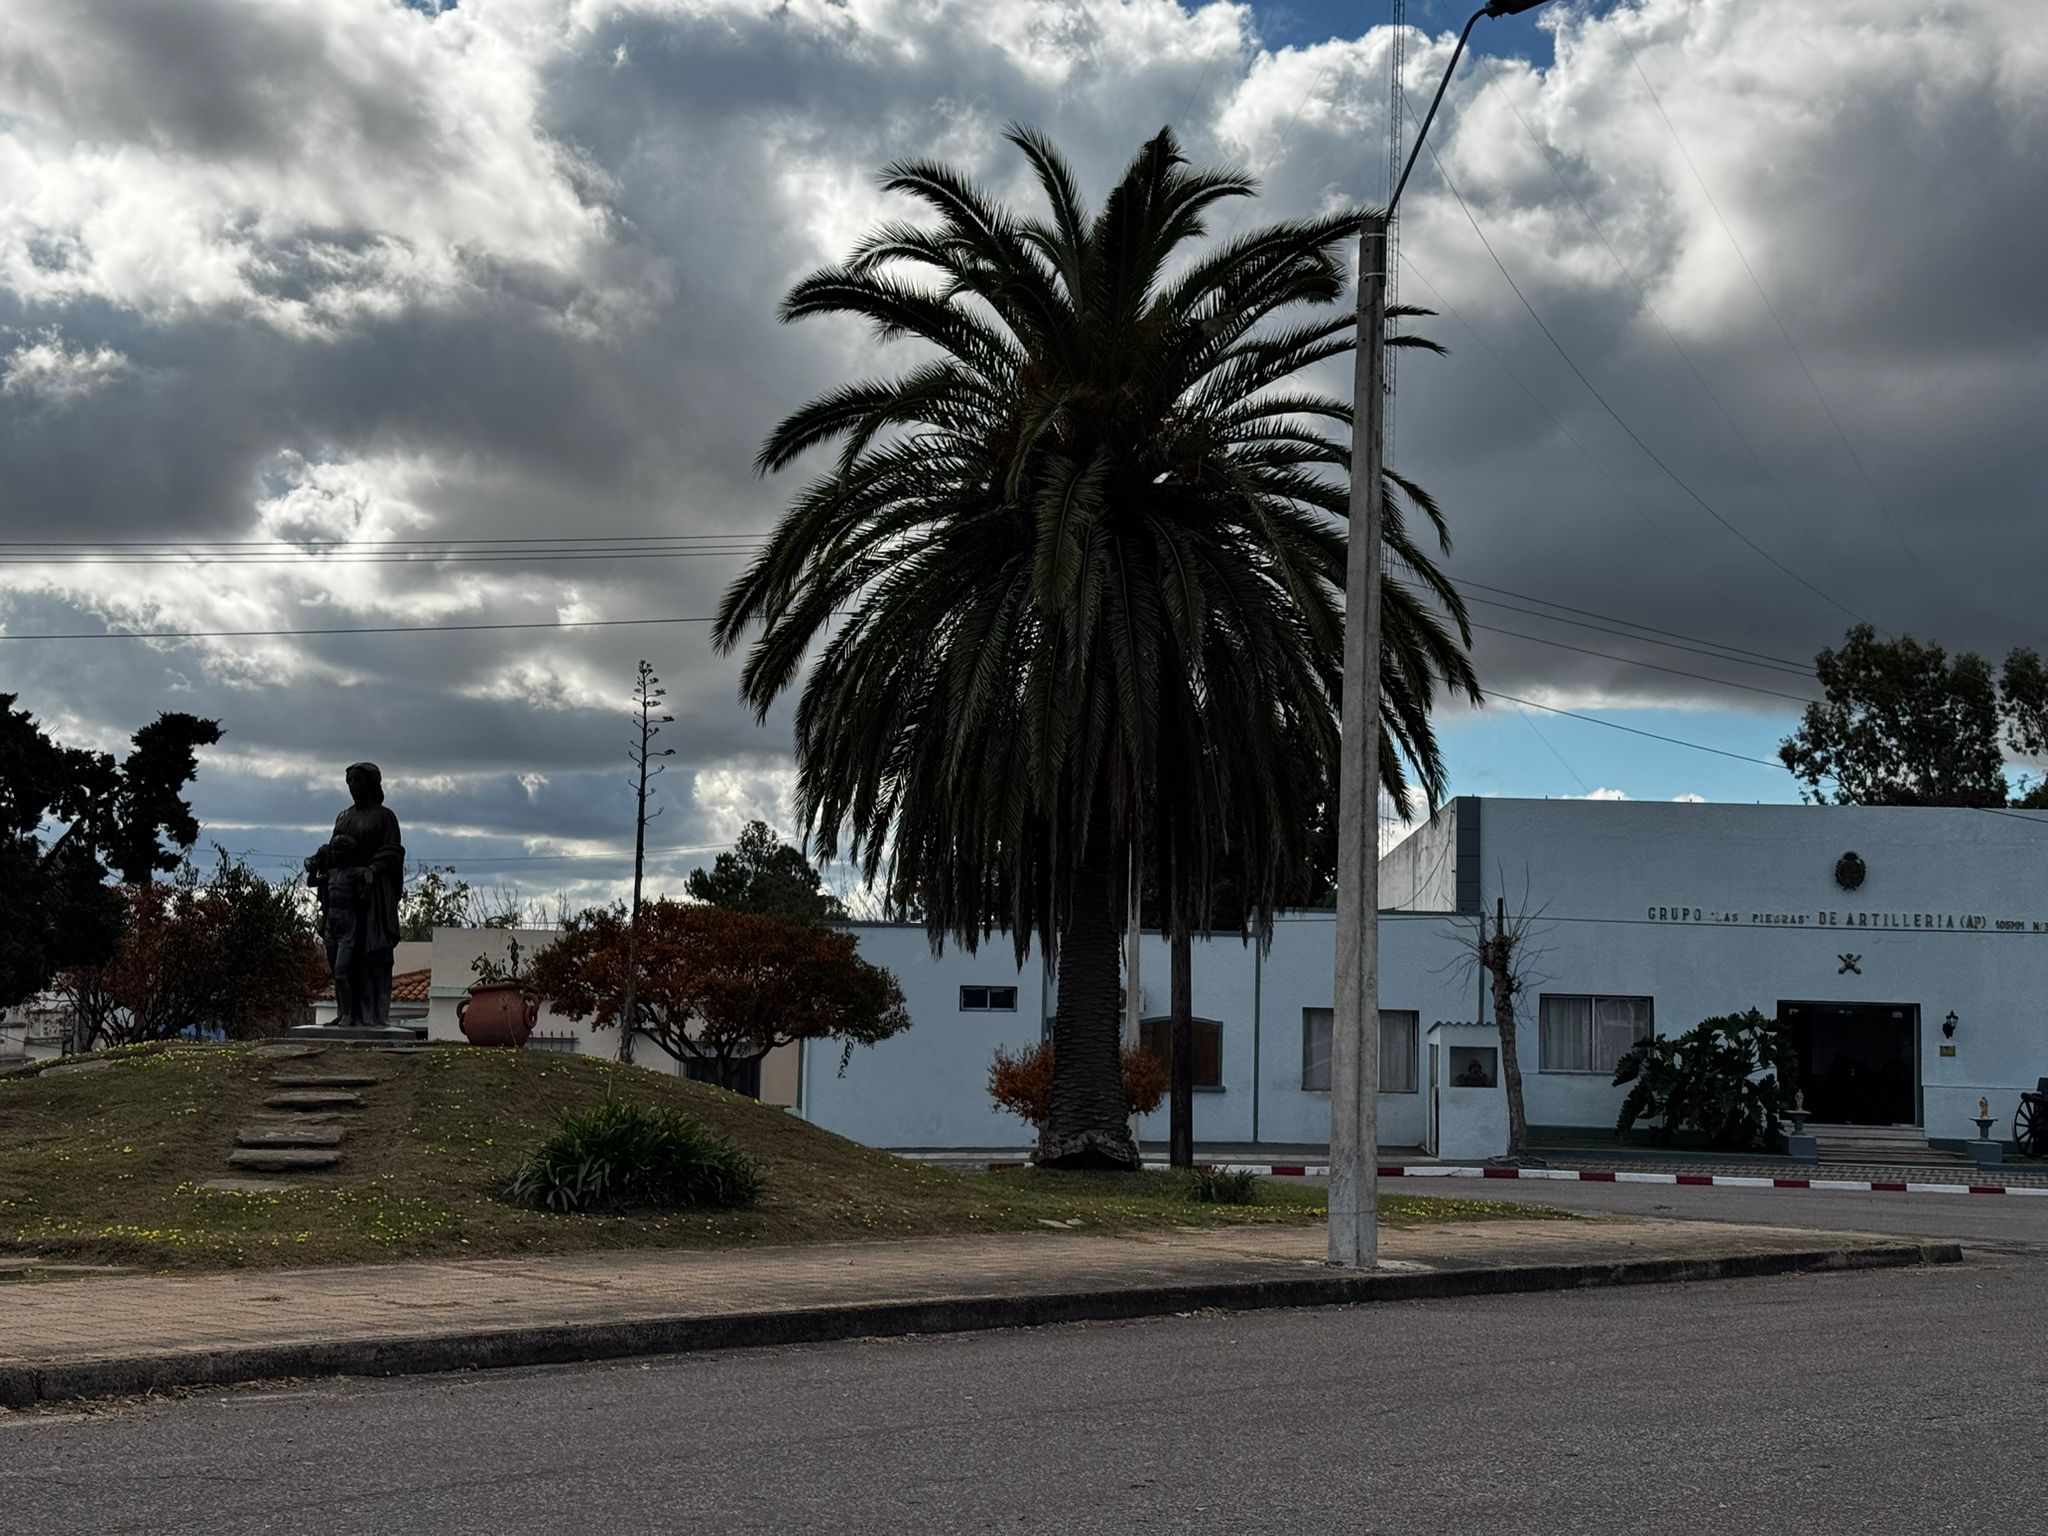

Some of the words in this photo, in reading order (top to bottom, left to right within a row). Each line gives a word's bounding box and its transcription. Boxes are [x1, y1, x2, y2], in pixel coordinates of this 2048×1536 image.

[1647, 906, 1702, 921] GRUPO
[1818, 911, 1838, 926] DE
[1846, 912, 1954, 928] ARTILLERIA
[1959, 914, 1987, 930] (AP)
